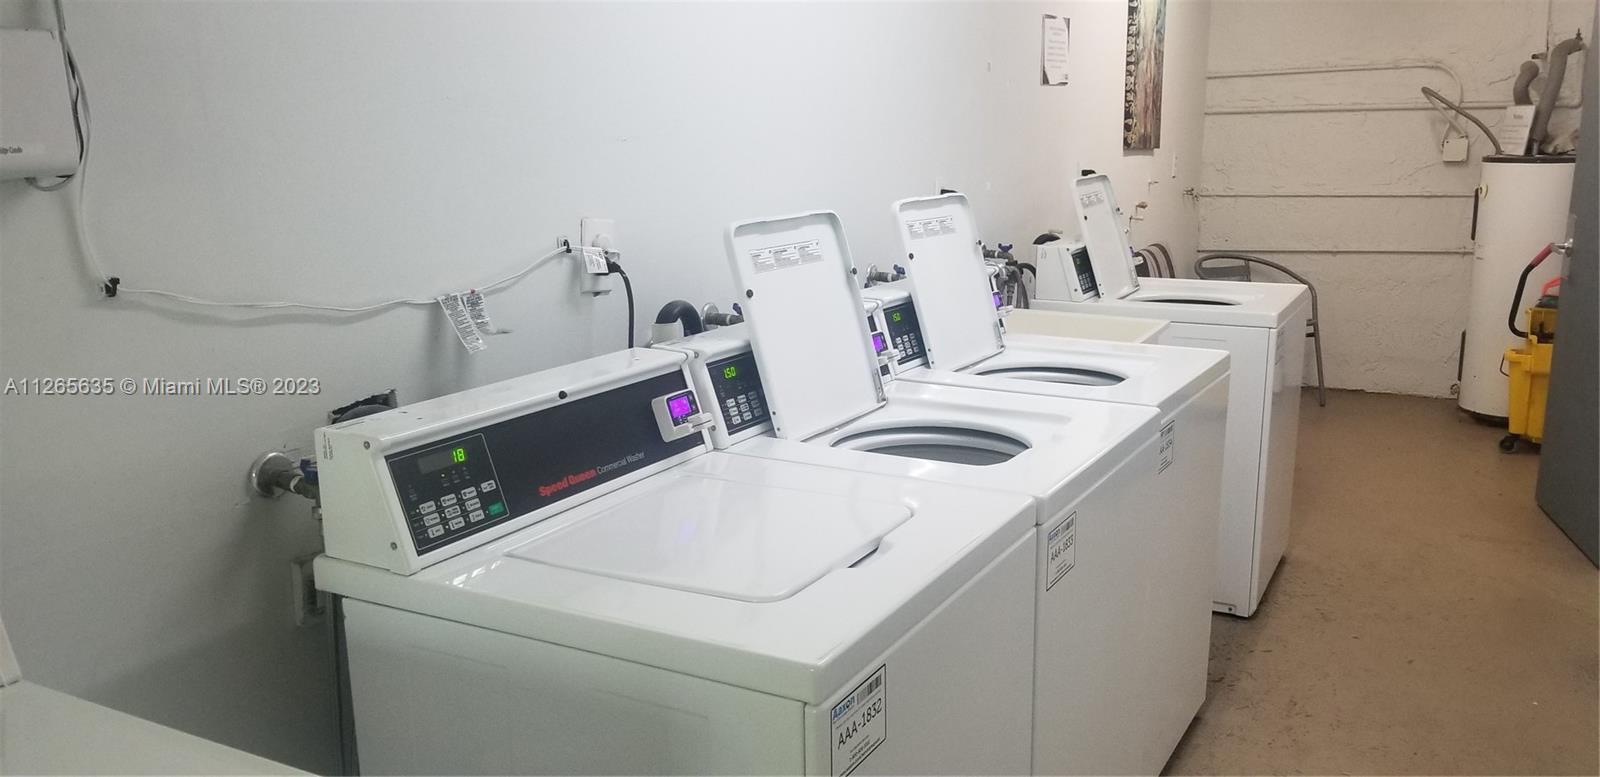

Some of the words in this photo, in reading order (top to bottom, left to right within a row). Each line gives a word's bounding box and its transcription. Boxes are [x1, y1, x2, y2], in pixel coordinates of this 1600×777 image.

[452, 447, 466, 463] 18
[538, 476, 568, 497] Speed
[568, 468, 597, 485] Queen
[597, 457, 627, 474] Commercial
[626, 450, 646, 464] Washer
[833, 695, 856, 721] Aaxon
[837, 697, 883, 751] AAA-1832
